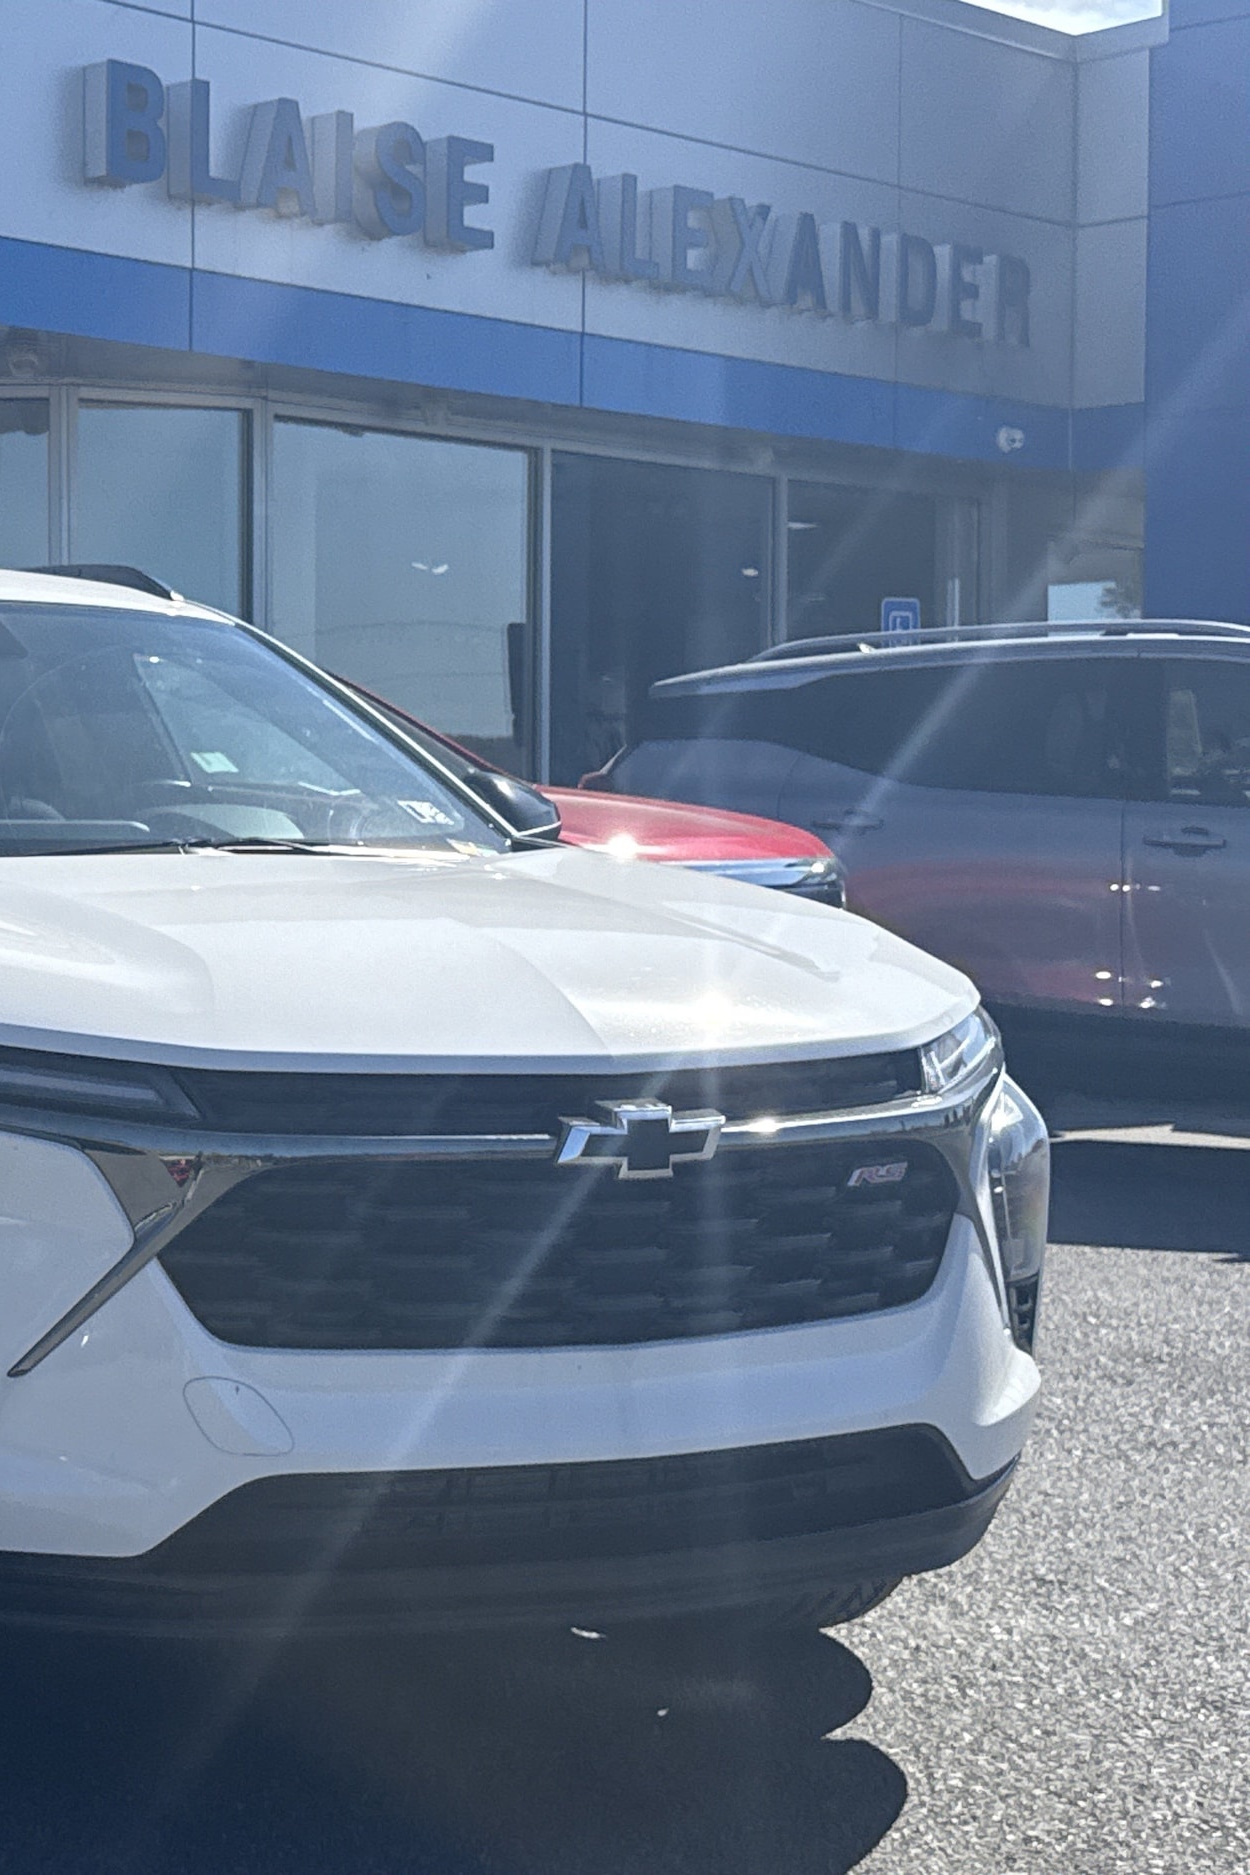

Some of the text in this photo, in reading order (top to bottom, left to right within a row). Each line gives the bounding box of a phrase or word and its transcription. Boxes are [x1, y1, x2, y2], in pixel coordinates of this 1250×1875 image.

[85, 58, 1031, 347] BLAISE ALEXANDER
[847, 1161, 908, 1186] RS
